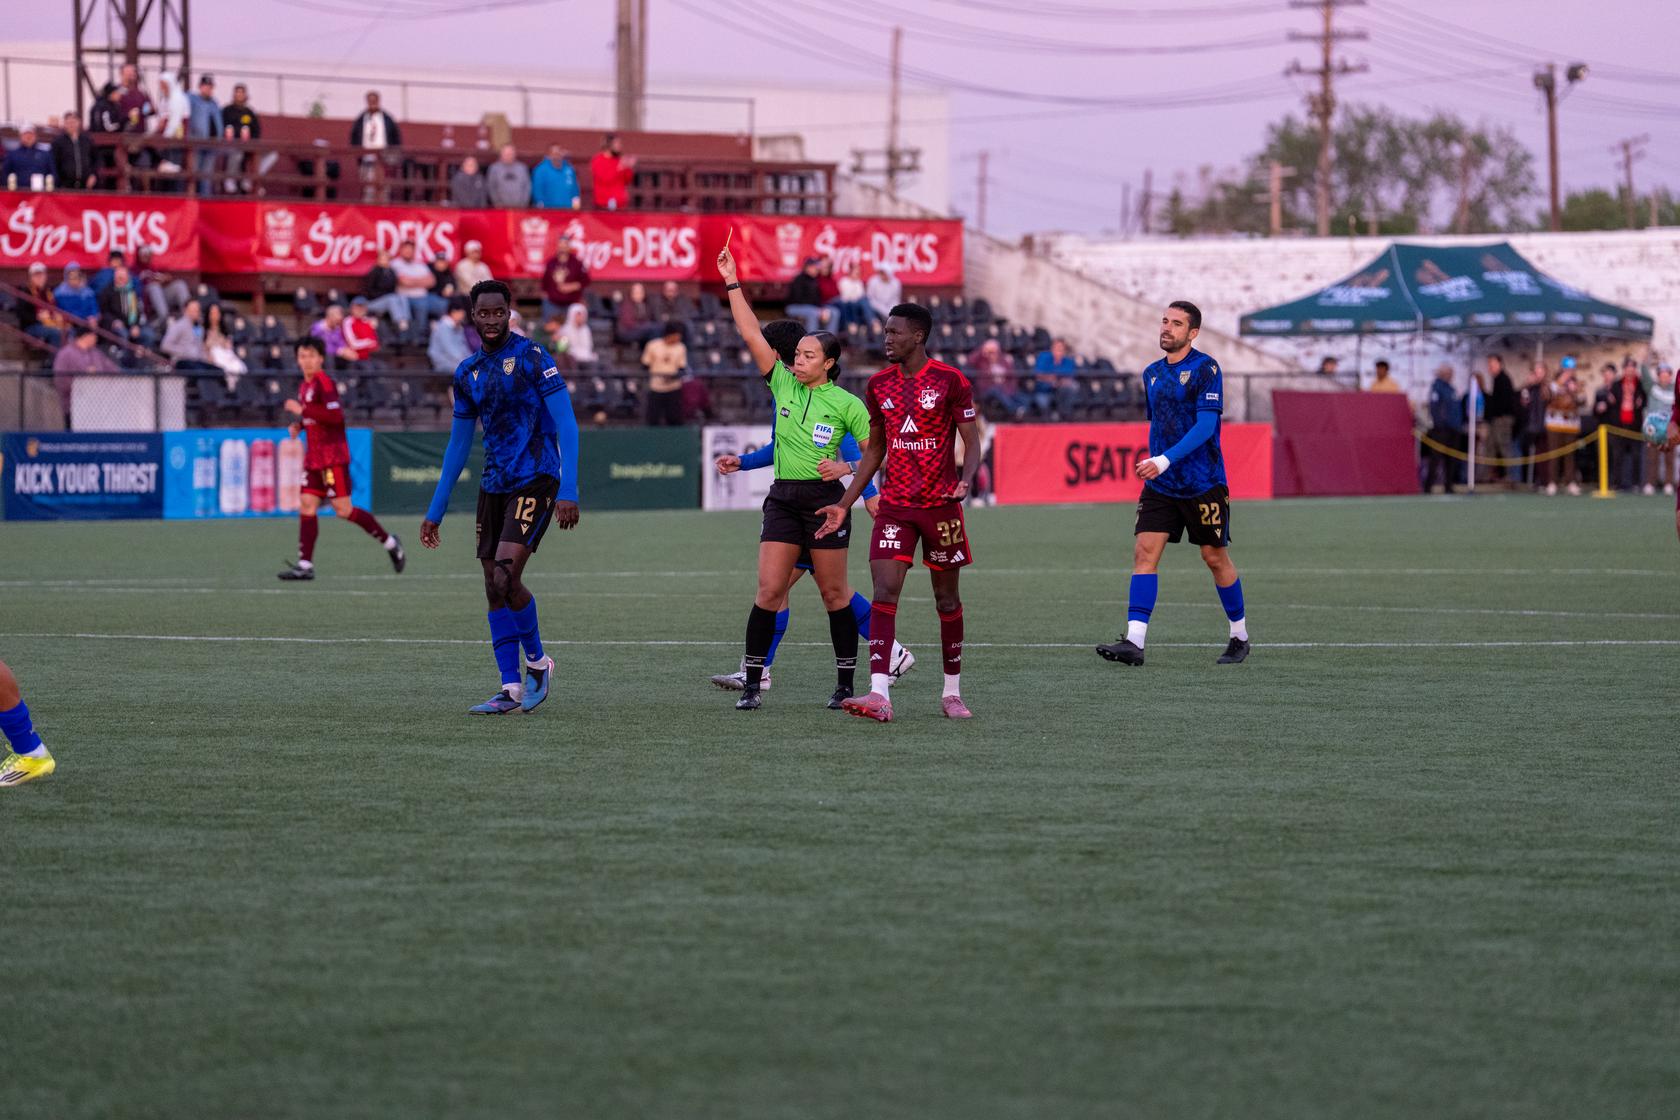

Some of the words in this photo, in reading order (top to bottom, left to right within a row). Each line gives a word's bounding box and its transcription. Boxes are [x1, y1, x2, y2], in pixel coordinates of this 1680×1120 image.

[815, 424, 832, 434] FIFA
[15, 463, 54, 494] KICK
[56, 463, 100, 494] YOUR
[102, 463, 158, 493] THIRST
[515, 496, 537, 522] 12
[1199, 502, 1221, 525] 22
[879, 540, 901, 549] DTE
[937, 519, 964, 546] 32
